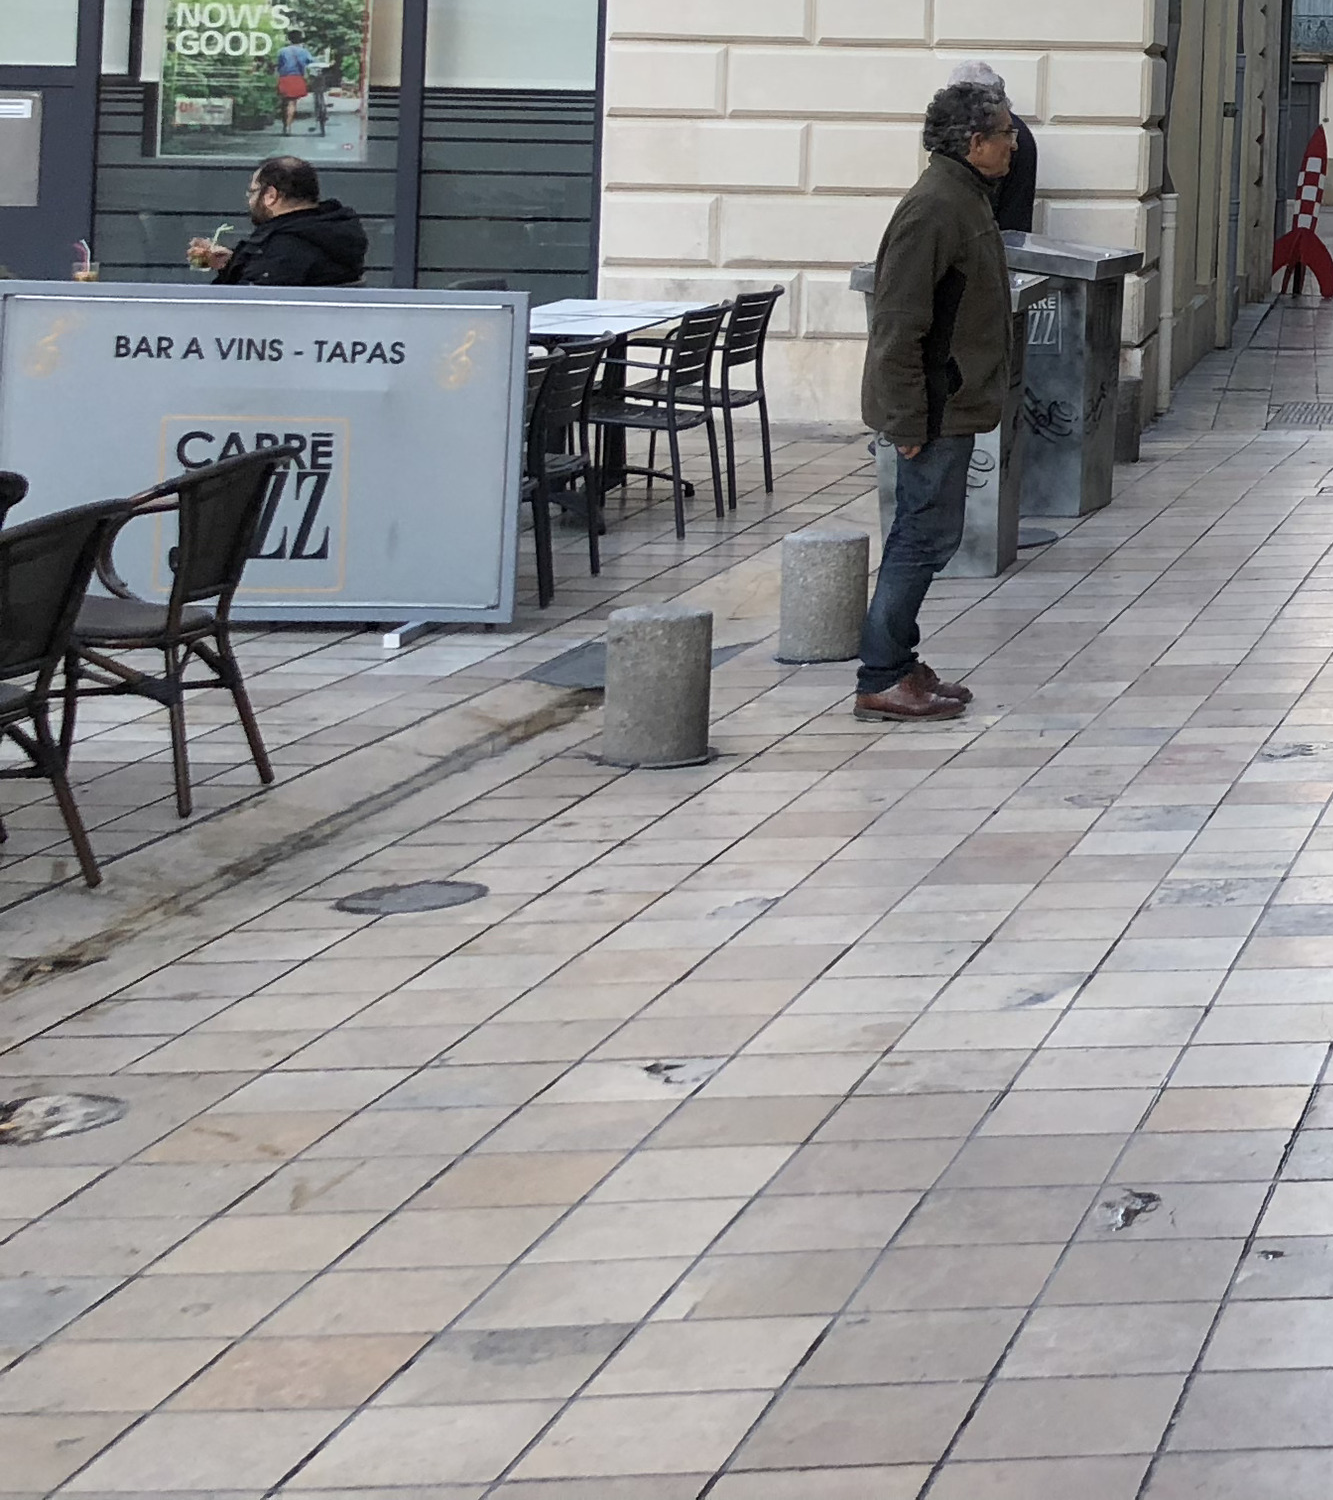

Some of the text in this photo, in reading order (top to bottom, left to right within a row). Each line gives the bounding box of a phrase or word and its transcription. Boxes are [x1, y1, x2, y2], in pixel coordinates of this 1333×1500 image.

[176, 3, 291, 29] NOW'S
[175, 30, 273, 56] GOOD
[1028, 310, 1056, 345] ZZ
[114, 335, 174, 359] BAR
[180, 336, 205, 360] A
[215, 337, 285, 362] VINS
[314, 340, 407, 365] TAPAS
